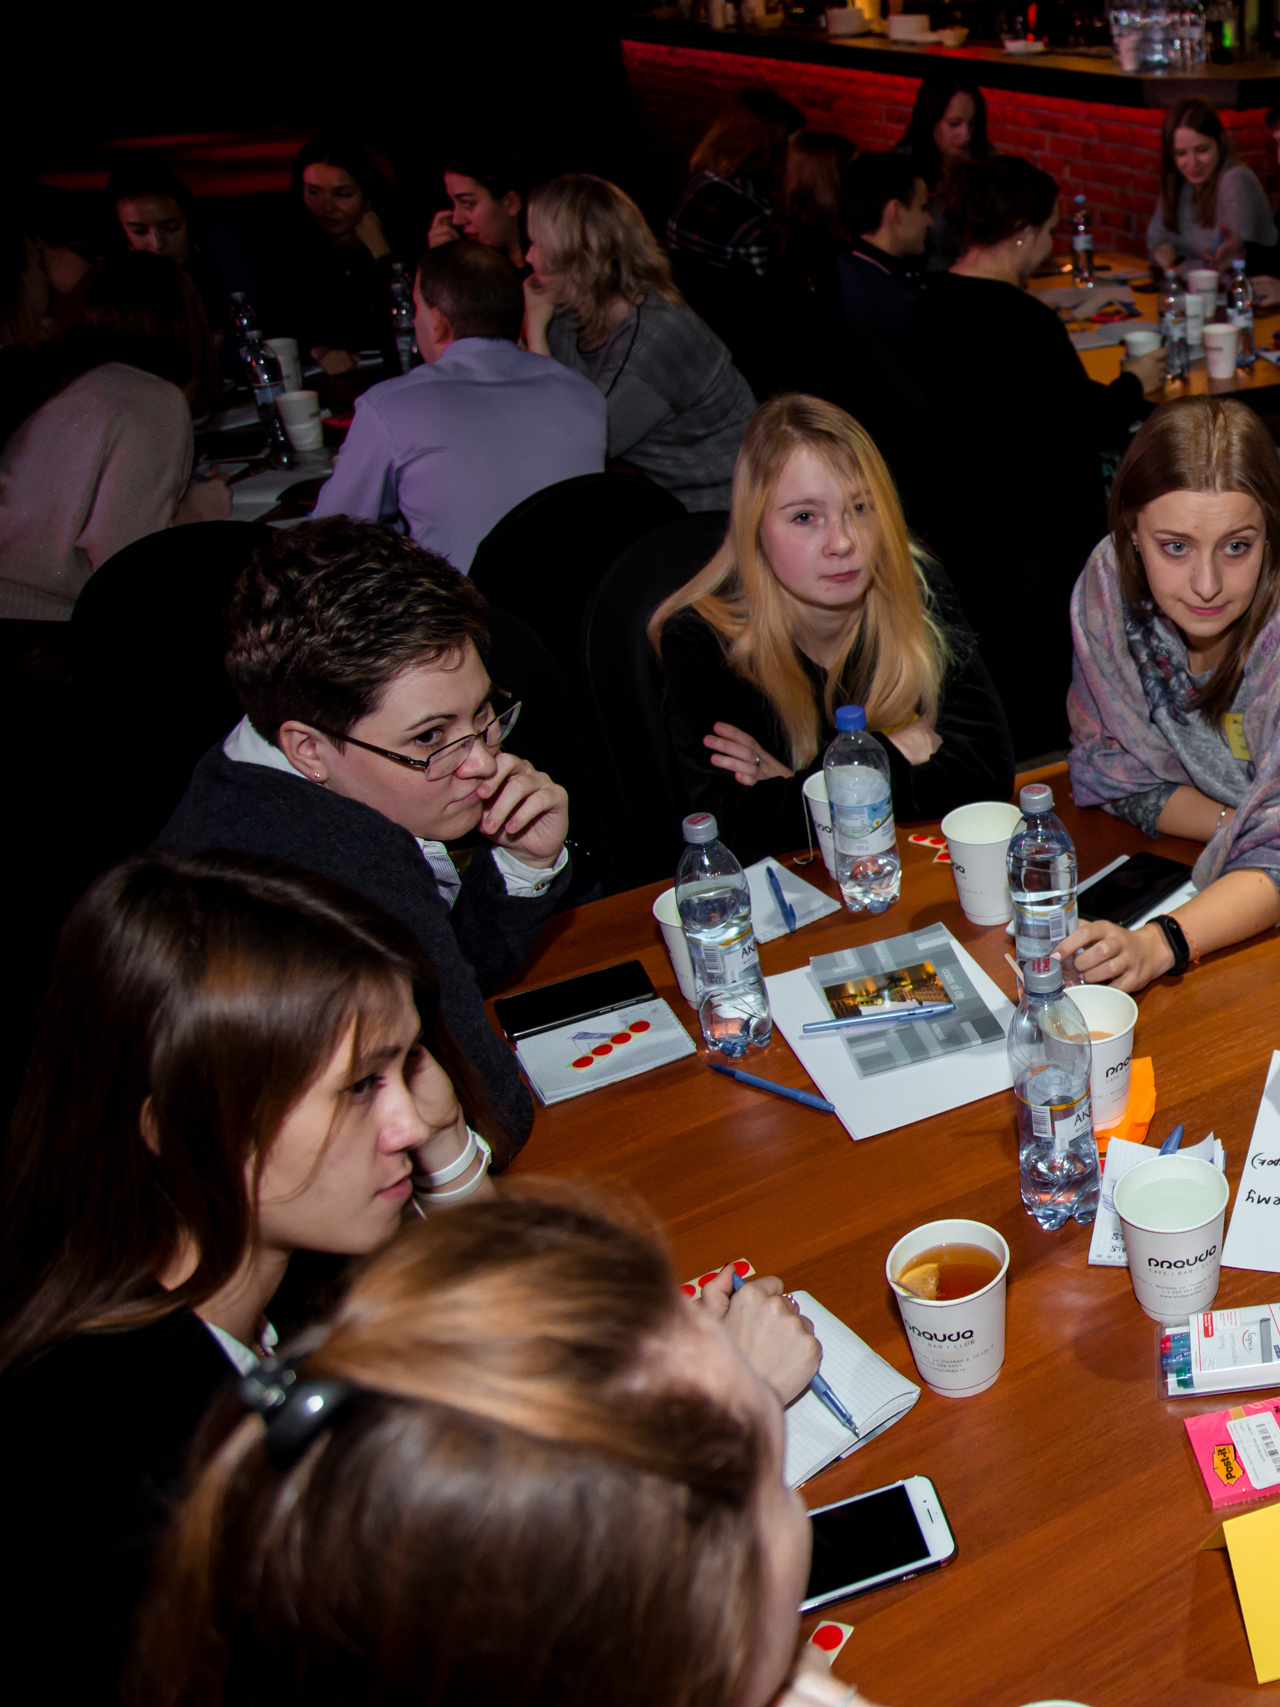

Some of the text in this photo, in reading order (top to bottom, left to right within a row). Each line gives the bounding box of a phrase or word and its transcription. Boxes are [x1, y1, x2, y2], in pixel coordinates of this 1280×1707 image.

[1148, 1268, 1167, 1276] CAFE
[1245, 1330, 1256, 1351] Topics
[1217, 1447, 1236, 1481] Post-it
